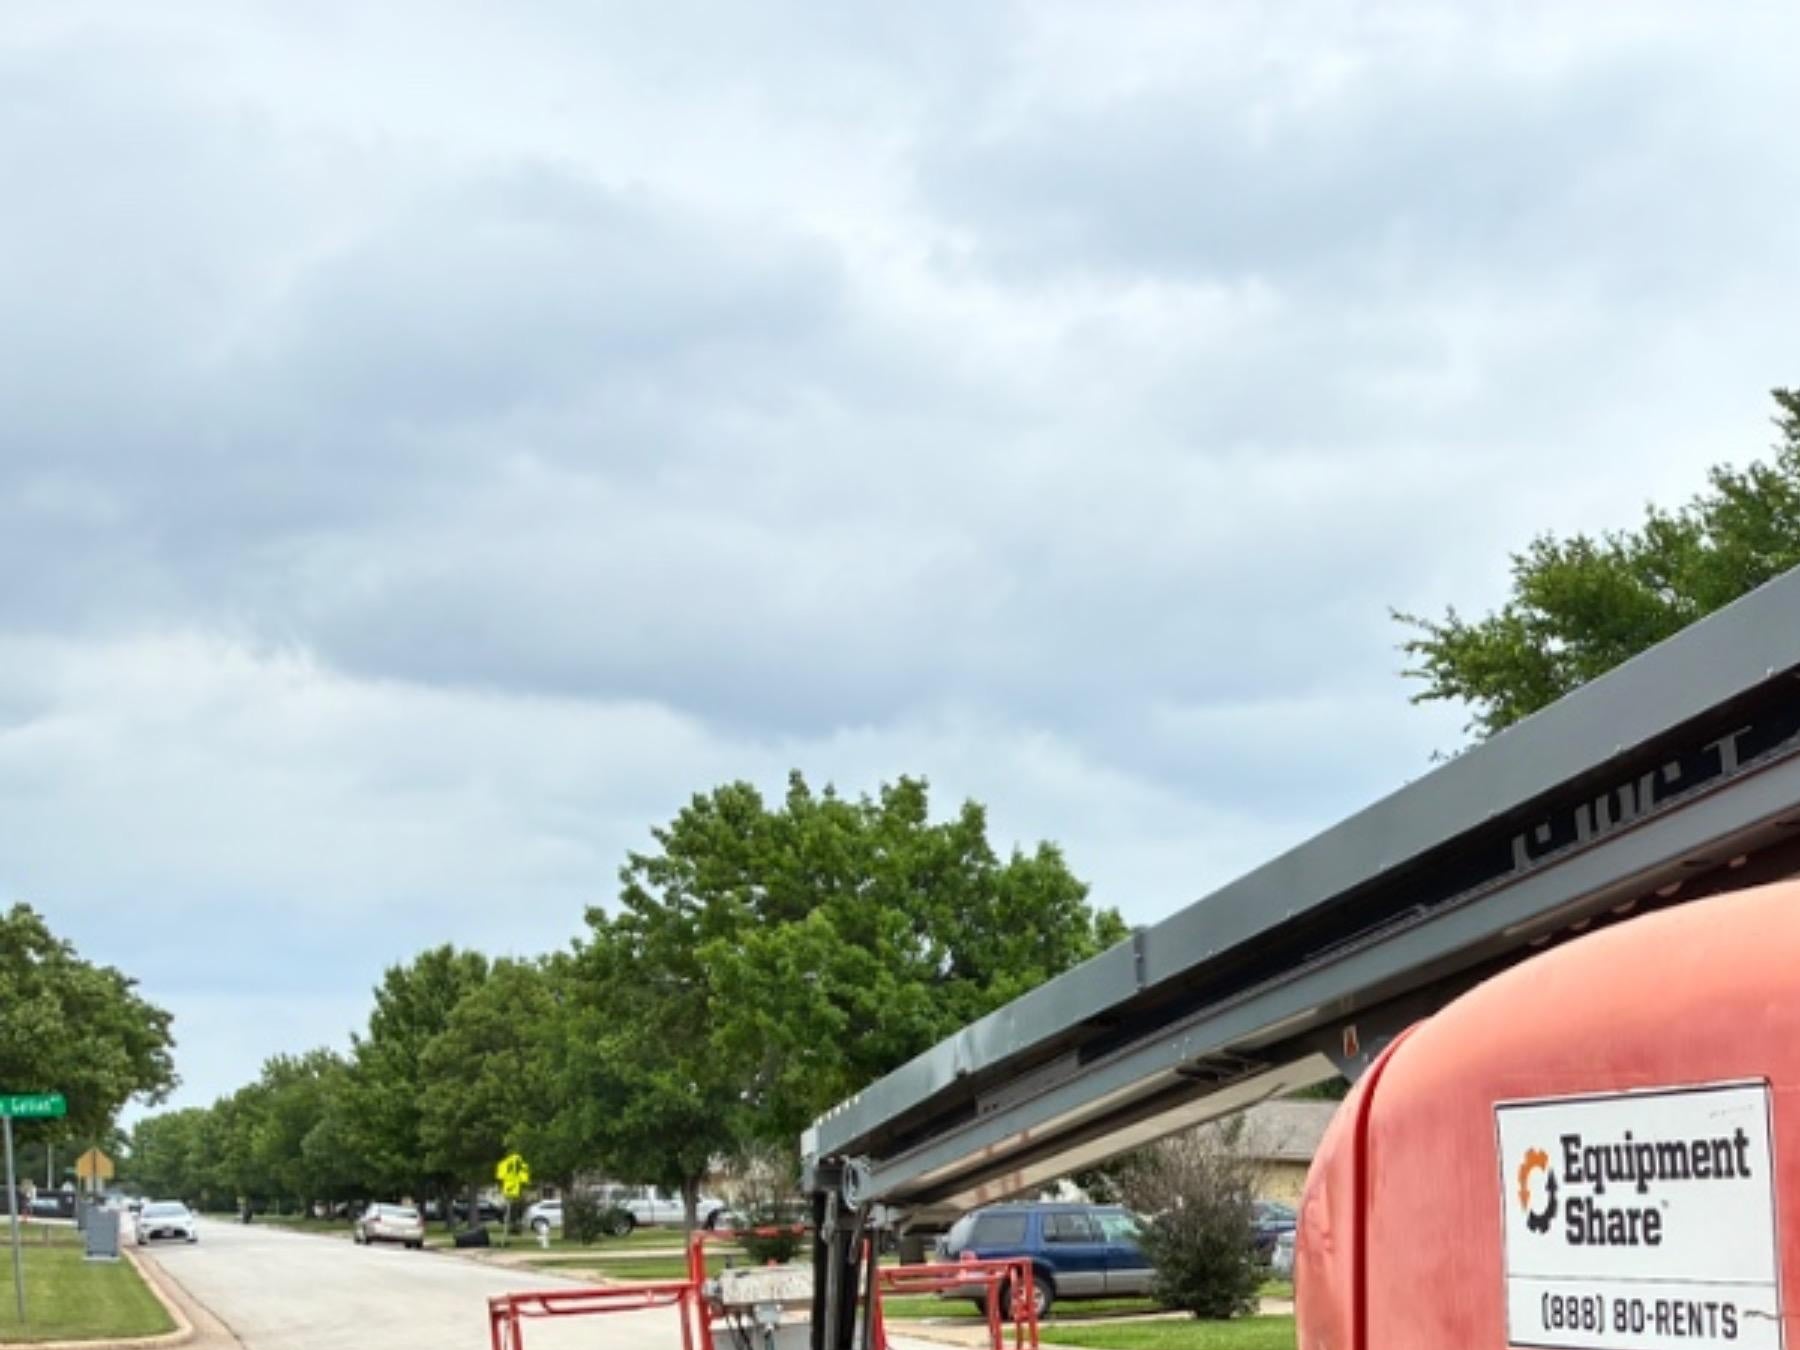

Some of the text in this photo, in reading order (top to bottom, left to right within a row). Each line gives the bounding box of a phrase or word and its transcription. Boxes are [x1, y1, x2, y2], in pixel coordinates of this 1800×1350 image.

[1560, 1127, 1751, 1195] Equipment
[1564, 1197, 1662, 1246] Share
[1541, 1292, 1605, 1334] (888)
